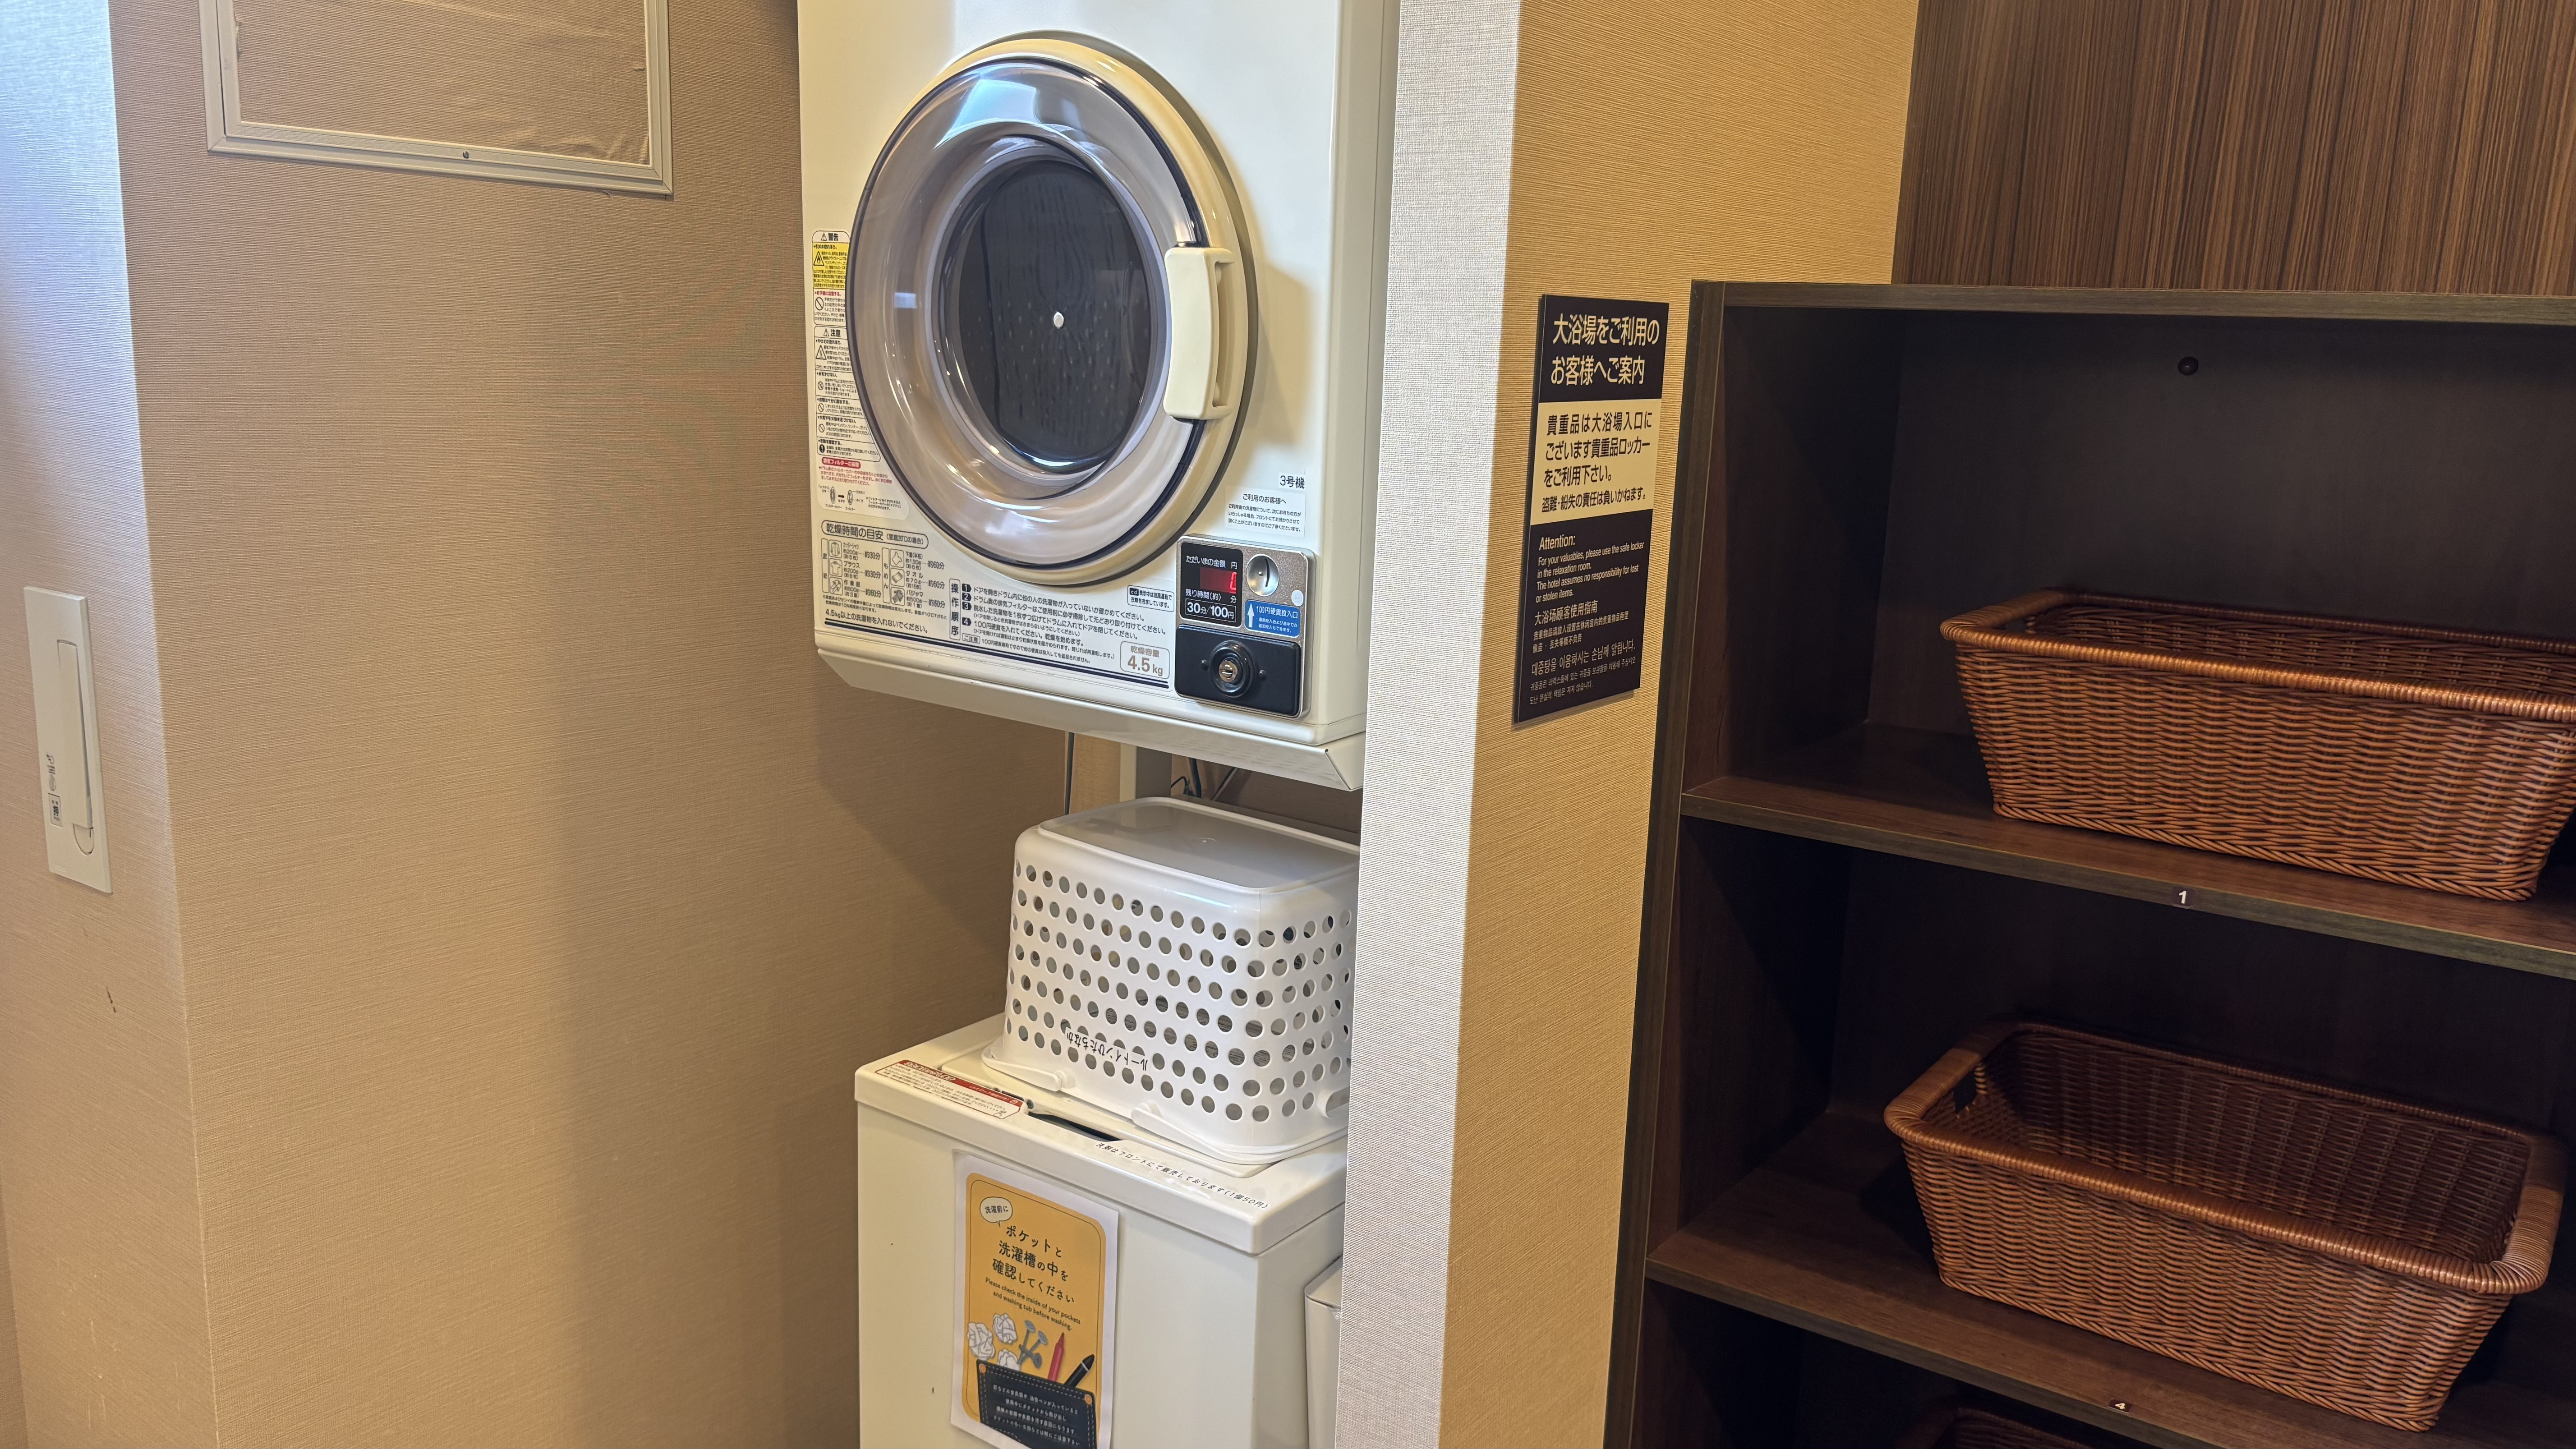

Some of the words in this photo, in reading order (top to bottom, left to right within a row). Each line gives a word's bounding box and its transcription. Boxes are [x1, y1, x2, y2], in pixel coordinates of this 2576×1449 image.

[1553, 313, 1660, 346] 大浴場をご利用の
[1550, 355, 1645, 386] お客様へご案内
[1546, 411, 1653, 436] 貴重品は大浴場入口に
[1546, 437, 1651, 461] ございます貴重品ロッカー
[1279, 475, 1305, 489] 3号機
[1544, 465, 1612, 488] をご利用下さい。
[1243, 493, 1287, 505] ご利用のお客様へ
[1541, 487, 1646, 513] 盗難・紛失の責任は負いかねます。
[826, 523, 884, 541] 乾燥時間の目安
[1539, 534, 1576, 551] Attention:
[1186, 555, 1226, 568] ただいまの金額
[1231, 561, 1237, 570] 円
[1538, 557, 1547, 566] For
[1547, 556, 1559, 567] your
[1560, 551, 1584, 562] valuables,
[1585, 548, 1601, 561] please
[1611, 545, 1619, 554] the
[1620, 543, 1630, 552] safe
[1630, 541, 1645, 550] locker
[906, 570, 923, 579] タオル
[1536, 581, 1547, 591] The
[1547, 579, 1560, 589] hotel
[1561, 575, 1583, 586] assumes
[1591, 567, 1623, 581] responsibility
[1630, 564, 1639, 573] lost
[1537, 569, 1542, 579] in
[1543, 568, 1552, 578] the
[1552, 564, 1577, 575] relaxation
[1578, 562, 1592, 571] room.
[1230, 595, 1237, 603] 分
[1542, 591, 1558, 602] stolen
[1559, 588, 1574, 599] items.
[951, 583, 959, 636] 操作順序
[1187, 602, 1234, 619] 30分/100円
[1256, 606, 1298, 619] 100円硬貨投入口
[1131, 646, 1160, 658] 乾燥容量
[1531, 658, 1557, 676] 대중탕을
[1559, 650, 1590, 669] 이용하시는
[1592, 644, 1609, 661] 손님께
[1611, 638, 1636, 656] 알립니다.
[1127, 655, 1150, 672] 4.5
[1153, 663, 1163, 676] kg
[2179, 890, 2187, 904] 1
[1067, 1032, 1148, 1071] ルートインひたちなか
[1095, 1142, 1269, 1209] 洗剤はフロントにて販売しております(1個50円)
[984, 1205, 1009, 1214] 洗濯前に
[1006, 1225, 1062, 1258] ポケットと
[999, 1240, 1068, 1281] 洗濯槽の中を
[992, 1258, 1074, 1303] 確認してください
[985, 1277, 1001, 1289] Please
[1002, 1285, 1016, 1295] check
[1017, 1292, 1025, 1300] the
[1026, 1295, 1041, 1306] inside
[1061, 1311, 1081, 1325] pockets
[1003, 1295, 1022, 1309] washing
[1033, 1308, 1050, 1320] before
